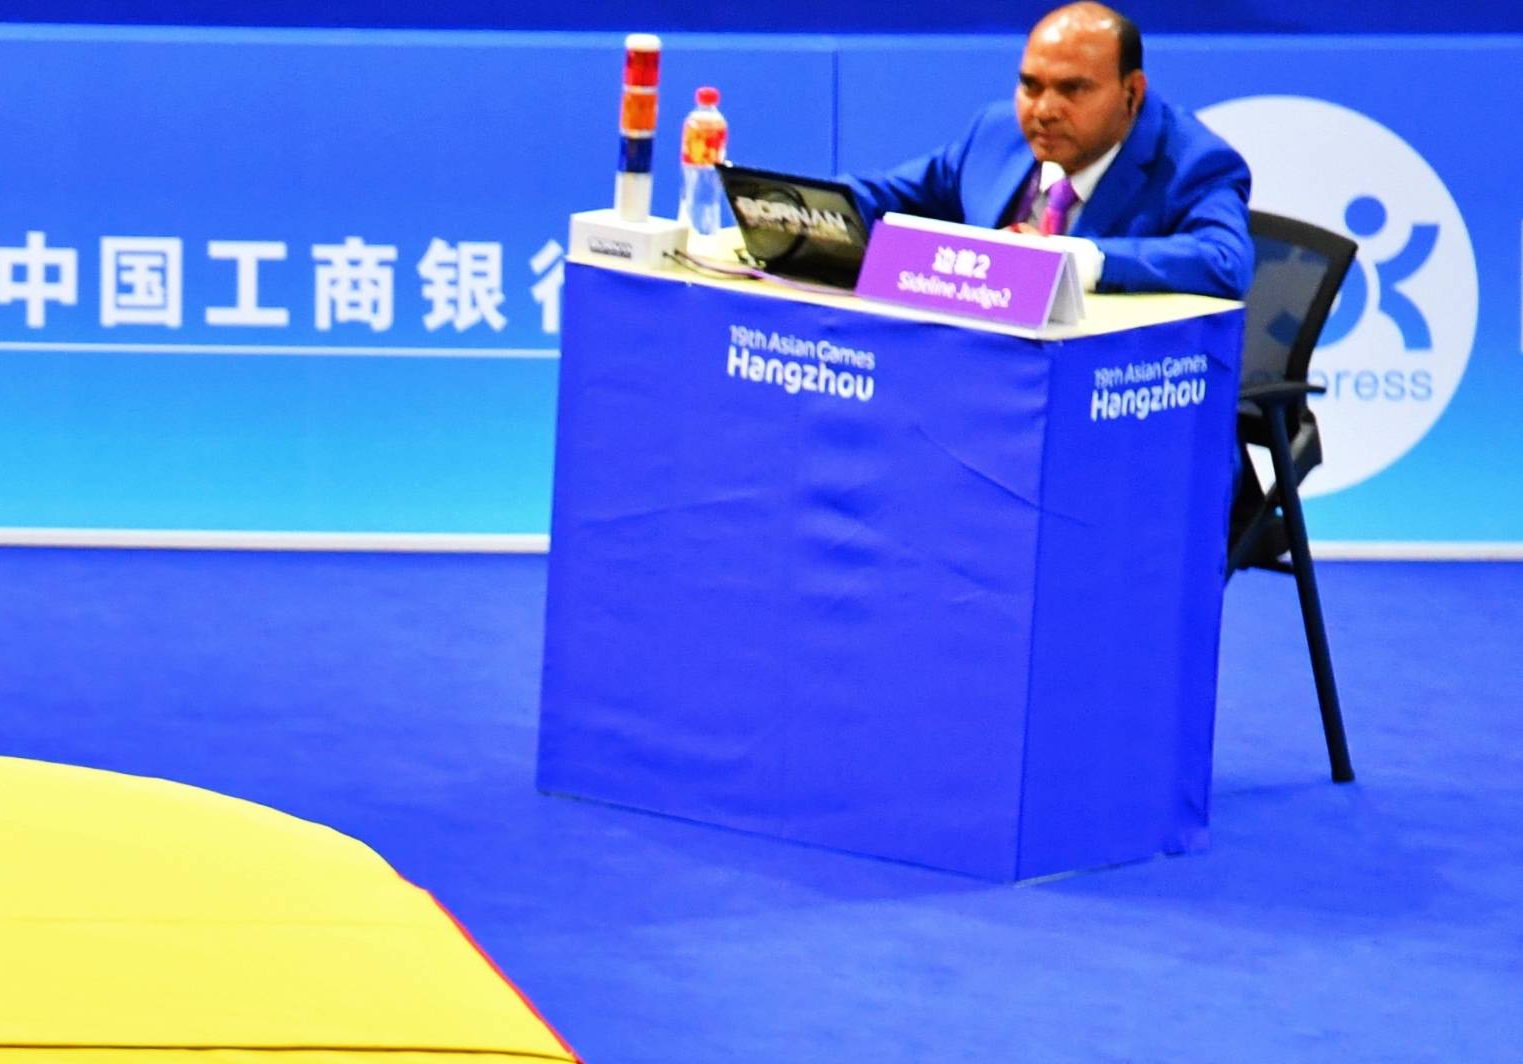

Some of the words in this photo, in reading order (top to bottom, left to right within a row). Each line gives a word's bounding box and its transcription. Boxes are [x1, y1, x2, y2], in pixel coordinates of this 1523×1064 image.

[767, 331, 816, 359] Asian
[816, 340, 876, 371] Games
[1124, 361, 1162, 385] Asian
[1162, 354, 1208, 379] Games
[727, 345, 875, 402] Hangzhou
[1090, 377, 1206, 422] Hangzhou
